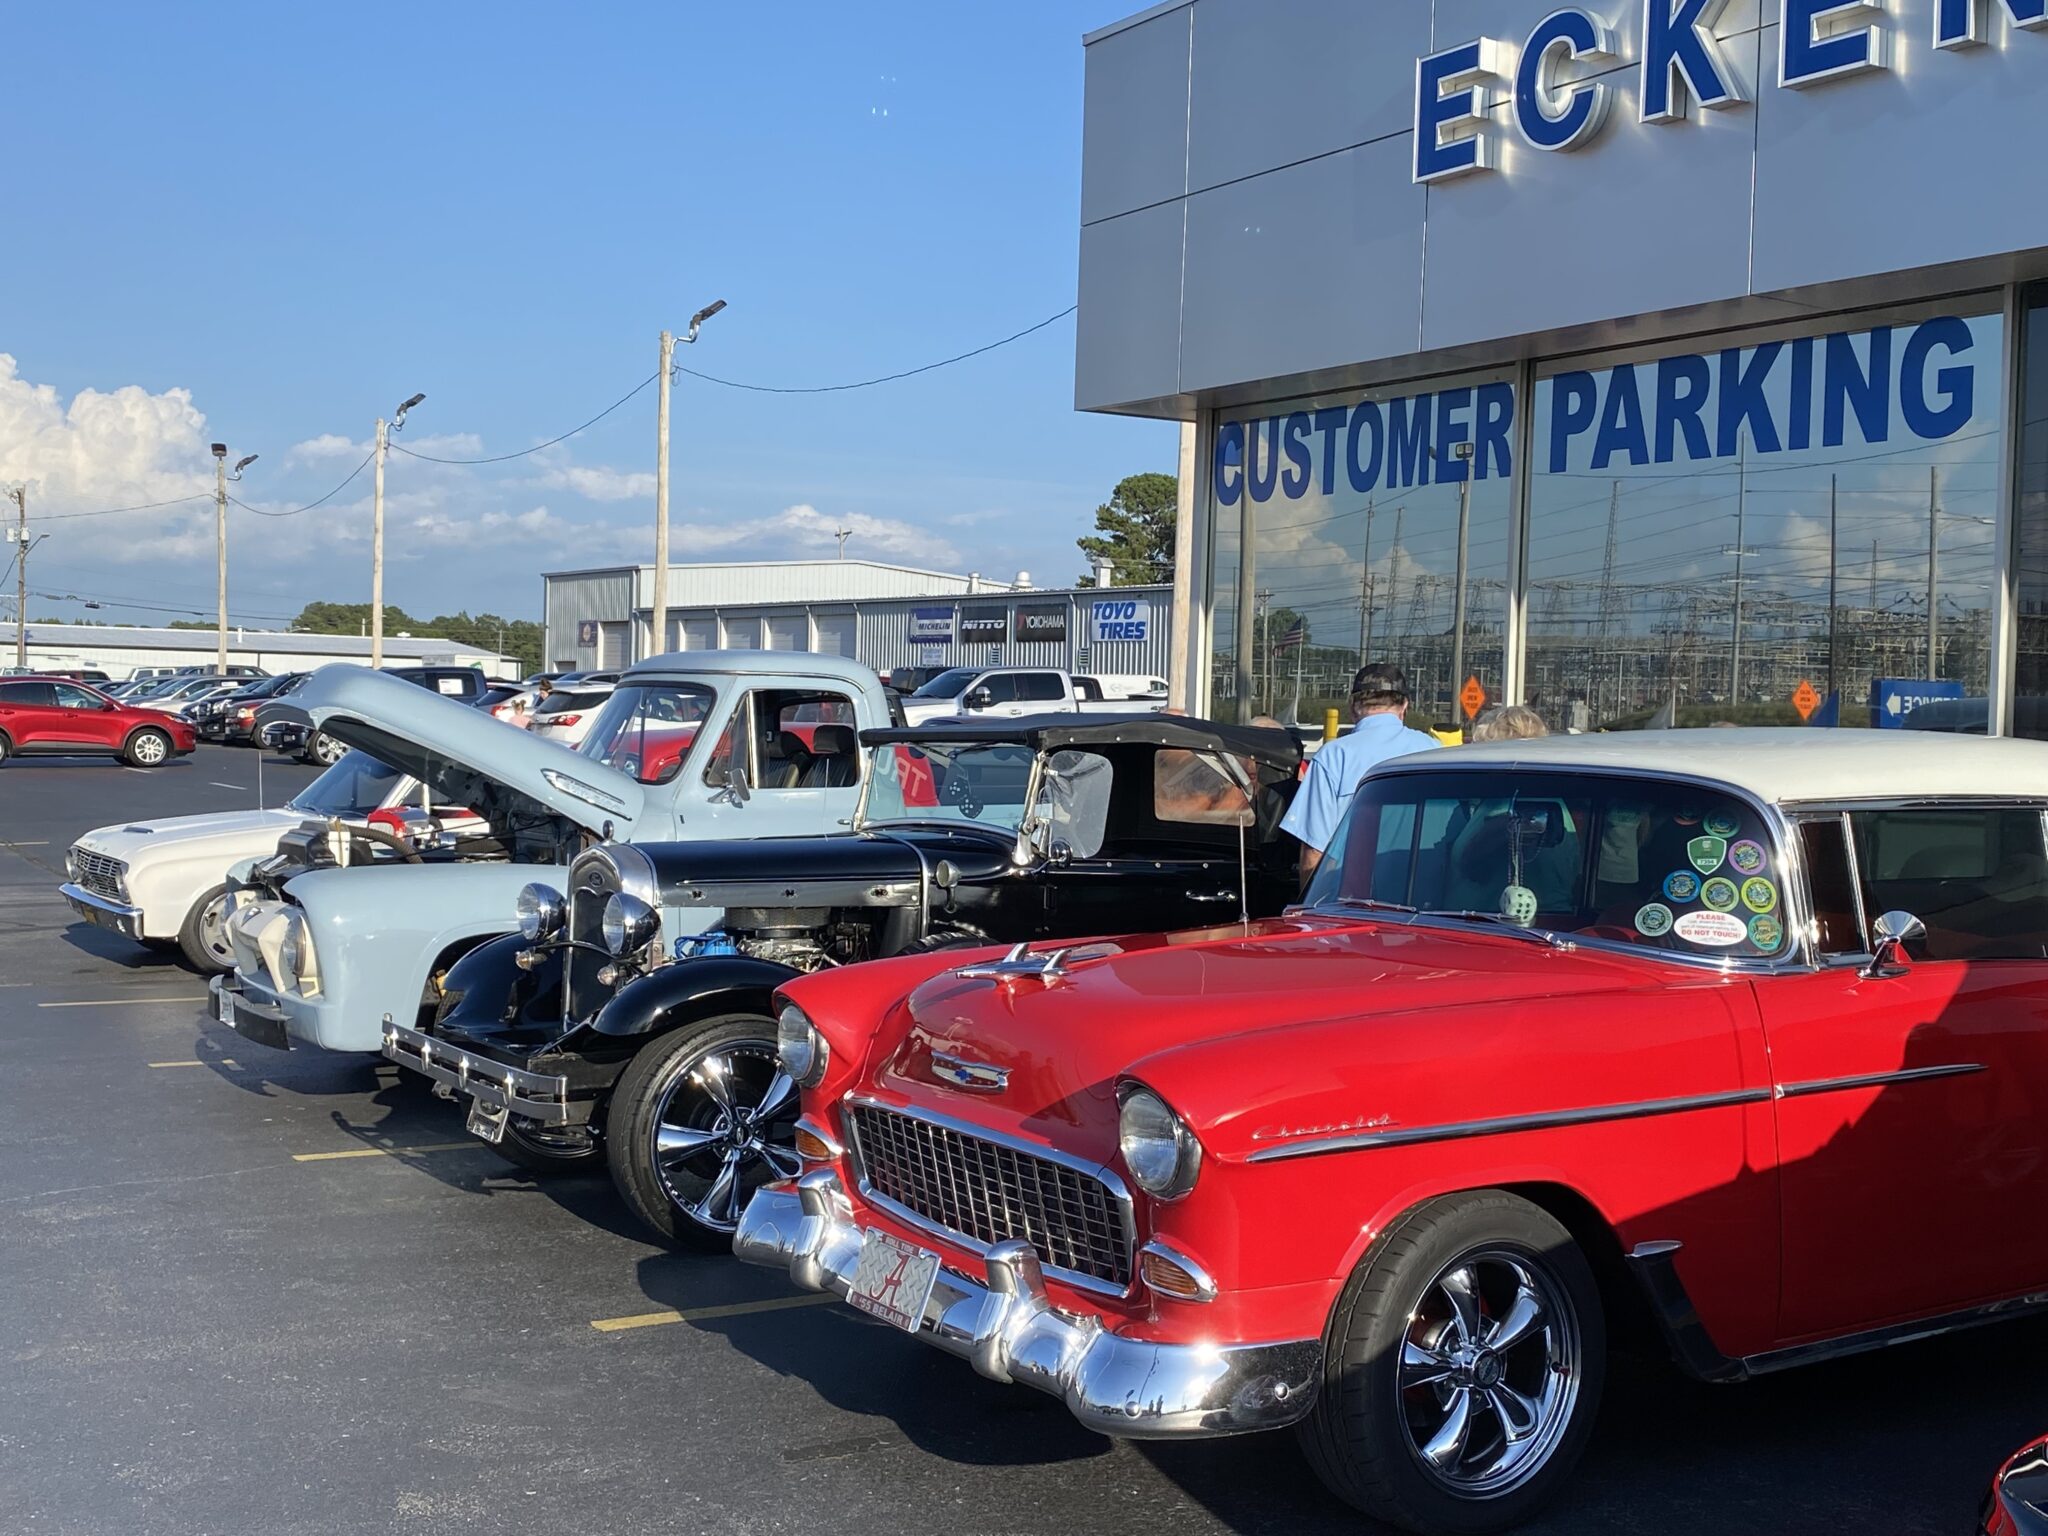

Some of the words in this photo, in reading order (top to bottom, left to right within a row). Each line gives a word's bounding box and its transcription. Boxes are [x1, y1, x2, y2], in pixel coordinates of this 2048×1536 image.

[1411, 0, 2048, 184] ECKE
[1214, 382, 1514, 506] CUSTOMER
[1549, 316, 1975, 474] PARKING
[1093, 601, 1136, 620] TOYO
[918, 622, 951, 631] MICHELIN
[961, 619, 1006, 630] NITTO
[1025, 614, 1065, 629] YOKOHAMA
[1098, 621, 1147, 640] TIRES
[1696, 913, 1726, 921] PLEASE
[872, 1302, 903, 1324] BELAIR
